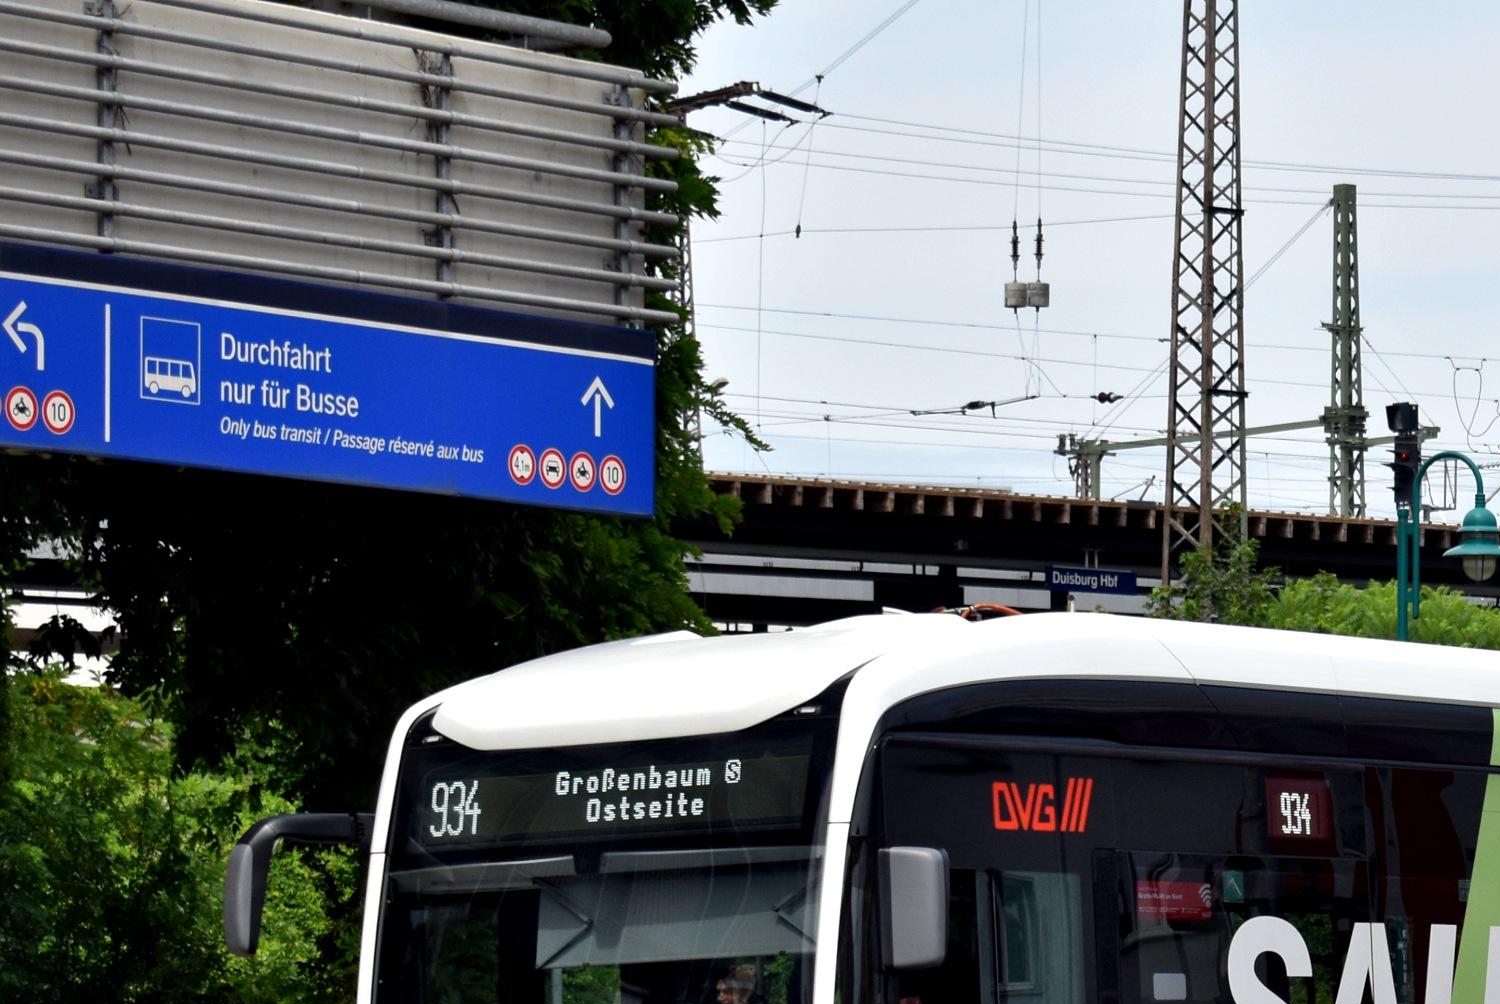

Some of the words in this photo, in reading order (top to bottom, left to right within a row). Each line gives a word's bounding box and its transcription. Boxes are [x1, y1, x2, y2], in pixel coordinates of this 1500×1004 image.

[220, 332, 332, 373] Durchfahrt
[51, 402, 67, 422] 10
[221, 380, 255, 405] nur
[260, 379, 292, 410] für
[296, 383, 360, 418] Busse
[220, 415, 251, 440] Only
[253, 419, 277, 440] bus
[280, 423, 322, 446] transit
[333, 429, 386, 455] Passage
[388, 436, 434, 458] réservé
[437, 443, 459, 461] aux
[461, 444, 485, 464] bus
[606, 466, 620, 484] 10
[1053, 571, 1098, 589] Duisburg
[1100, 575, 1119, 588] Hbf
[554, 764, 711, 796] Großenbaum
[430, 780, 482, 838] 934
[586, 792, 704, 823] Ostseite
[1279, 791, 1313, 836] 934
